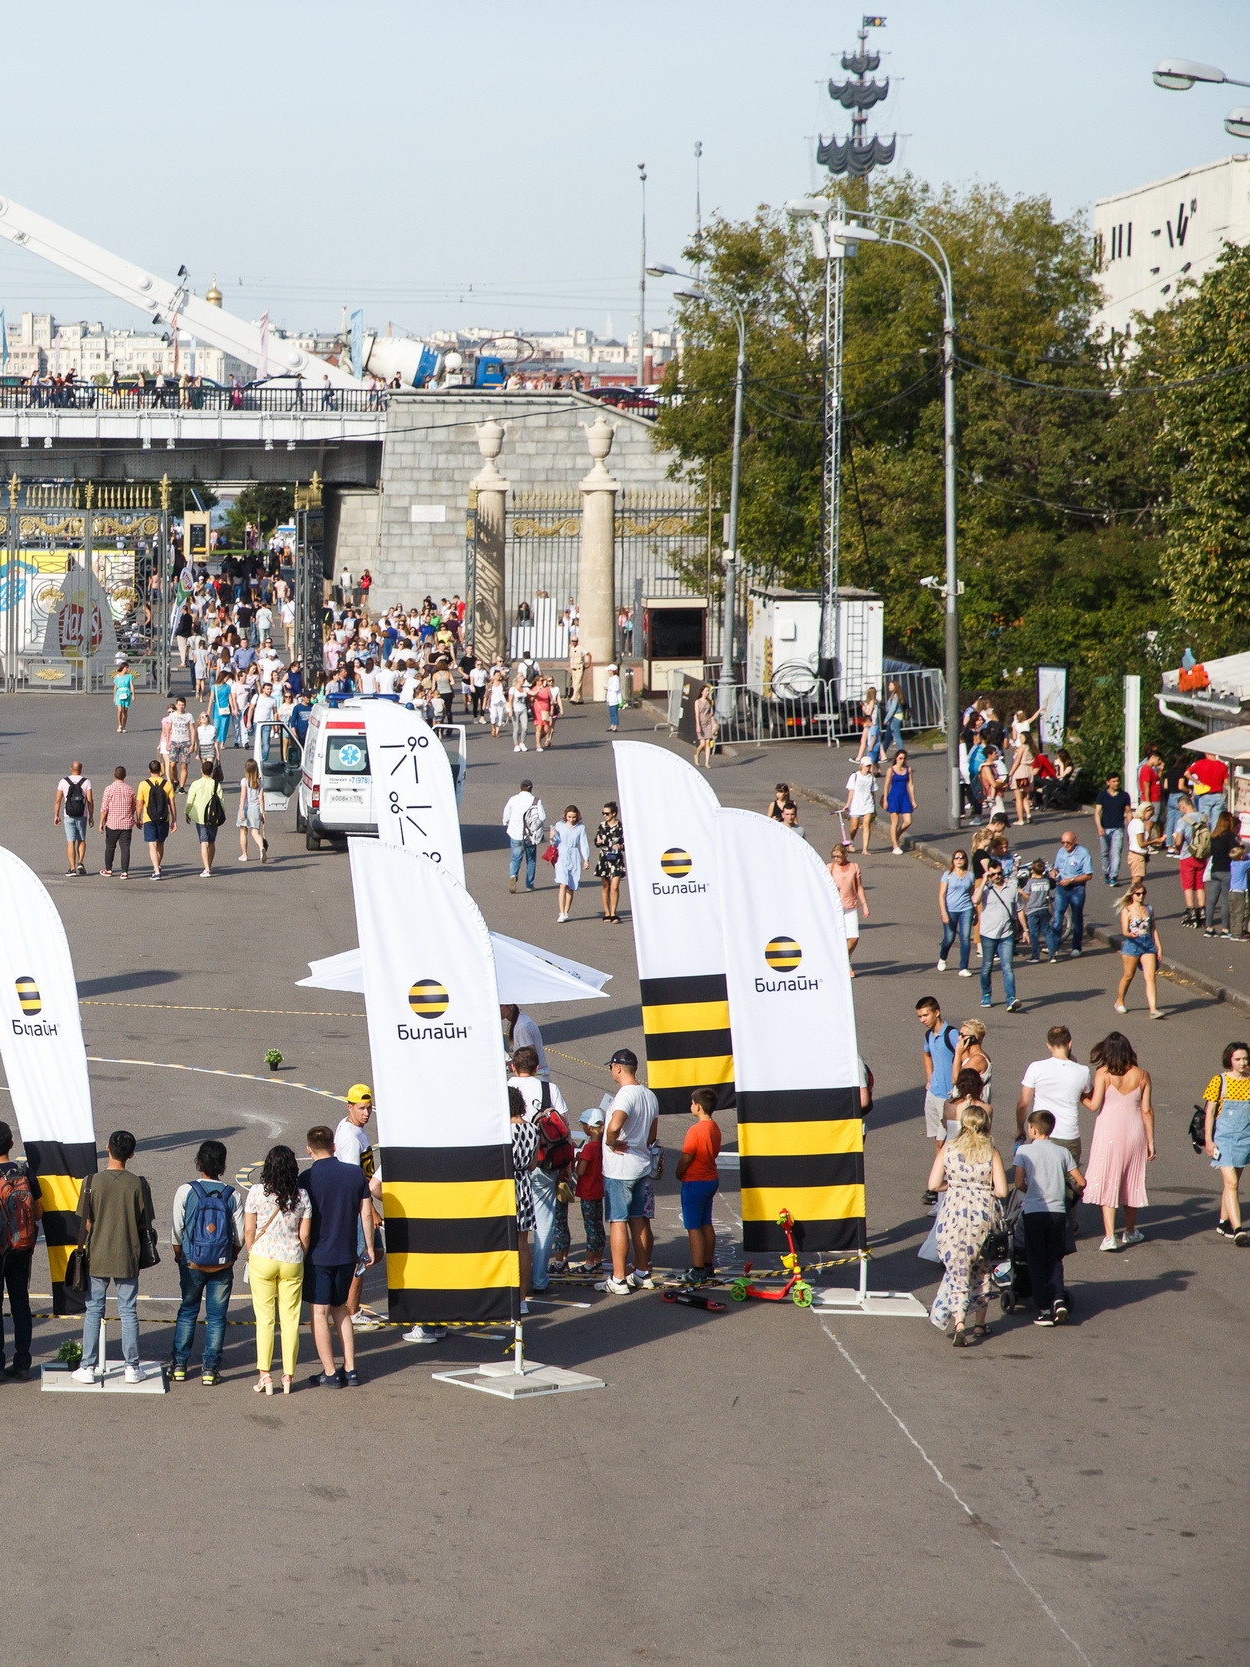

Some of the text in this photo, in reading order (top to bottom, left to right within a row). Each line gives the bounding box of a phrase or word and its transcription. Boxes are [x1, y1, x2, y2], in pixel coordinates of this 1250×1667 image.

[407, 736, 429, 752] 90
[652, 881, 707, 895] Билайн
[754, 976, 819, 993] Билайн
[397, 1023, 468, 1040] Билайн
